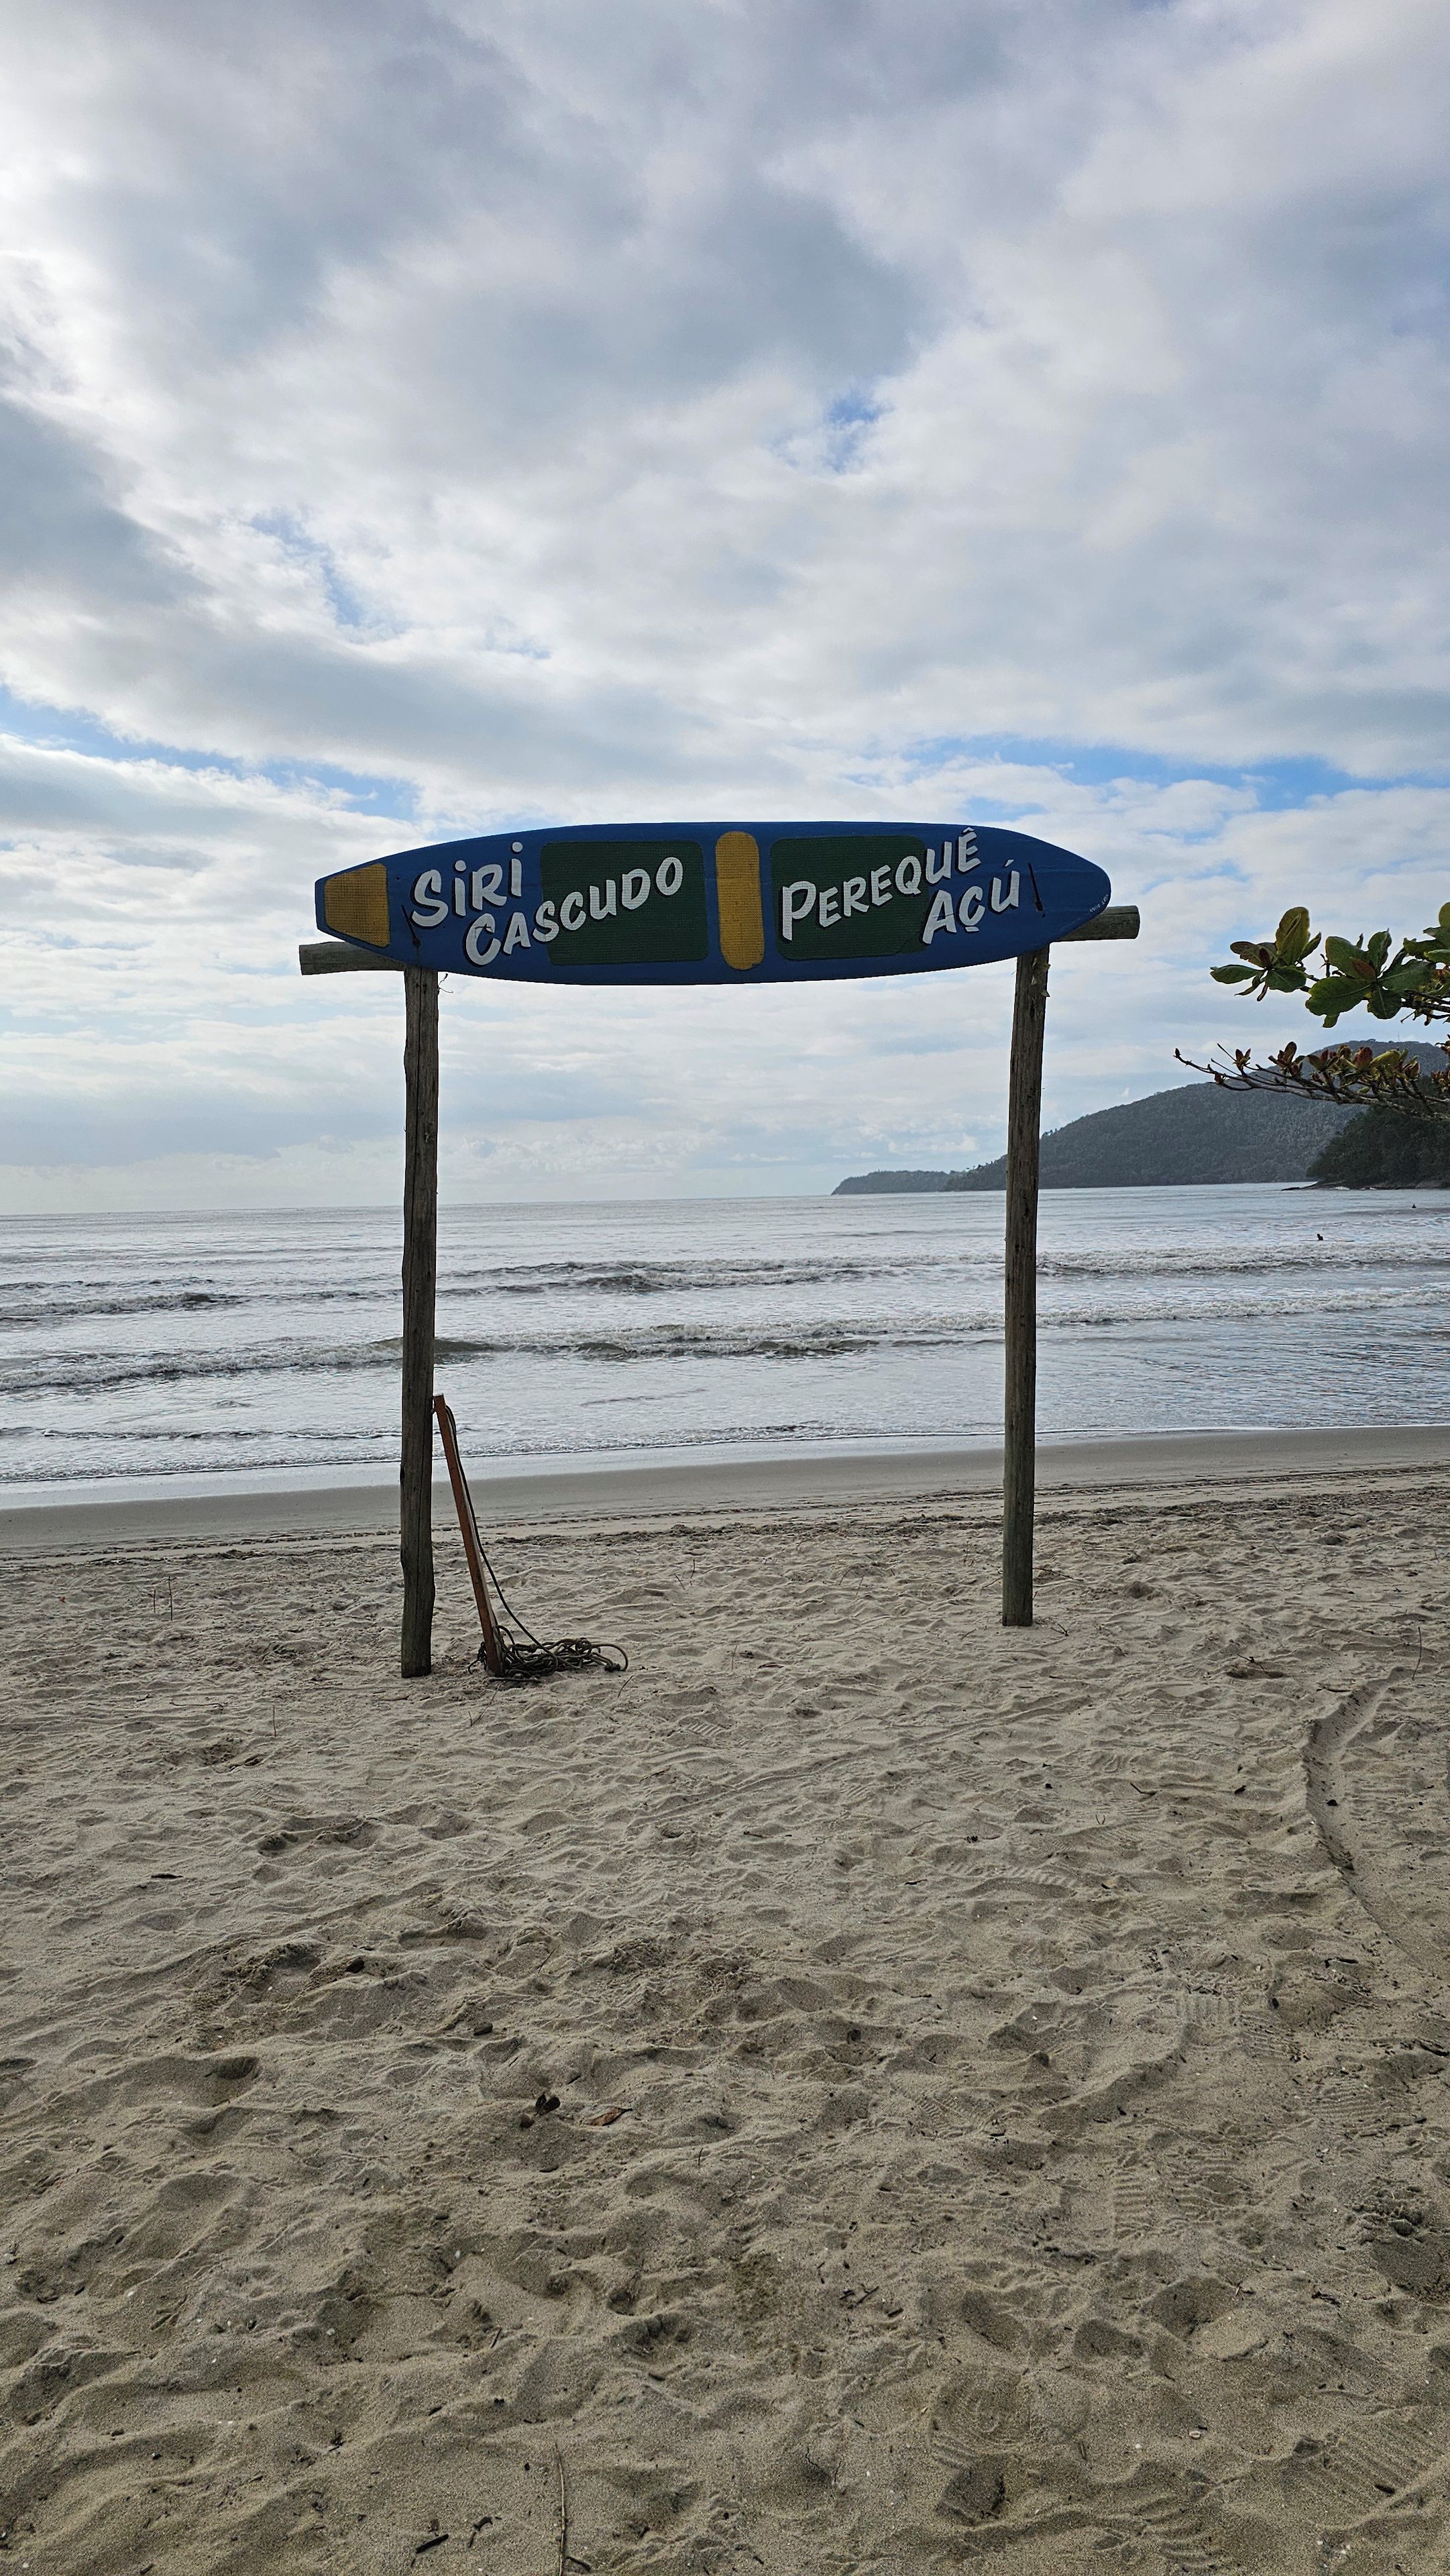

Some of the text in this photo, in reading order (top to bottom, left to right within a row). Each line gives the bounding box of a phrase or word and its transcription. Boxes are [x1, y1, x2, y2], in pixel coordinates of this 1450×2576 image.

[465, 857, 683, 965] CASCUDO
[782, 826, 981, 941] PEREQUÊ
[922, 859, 1019, 945] AÇÚ
